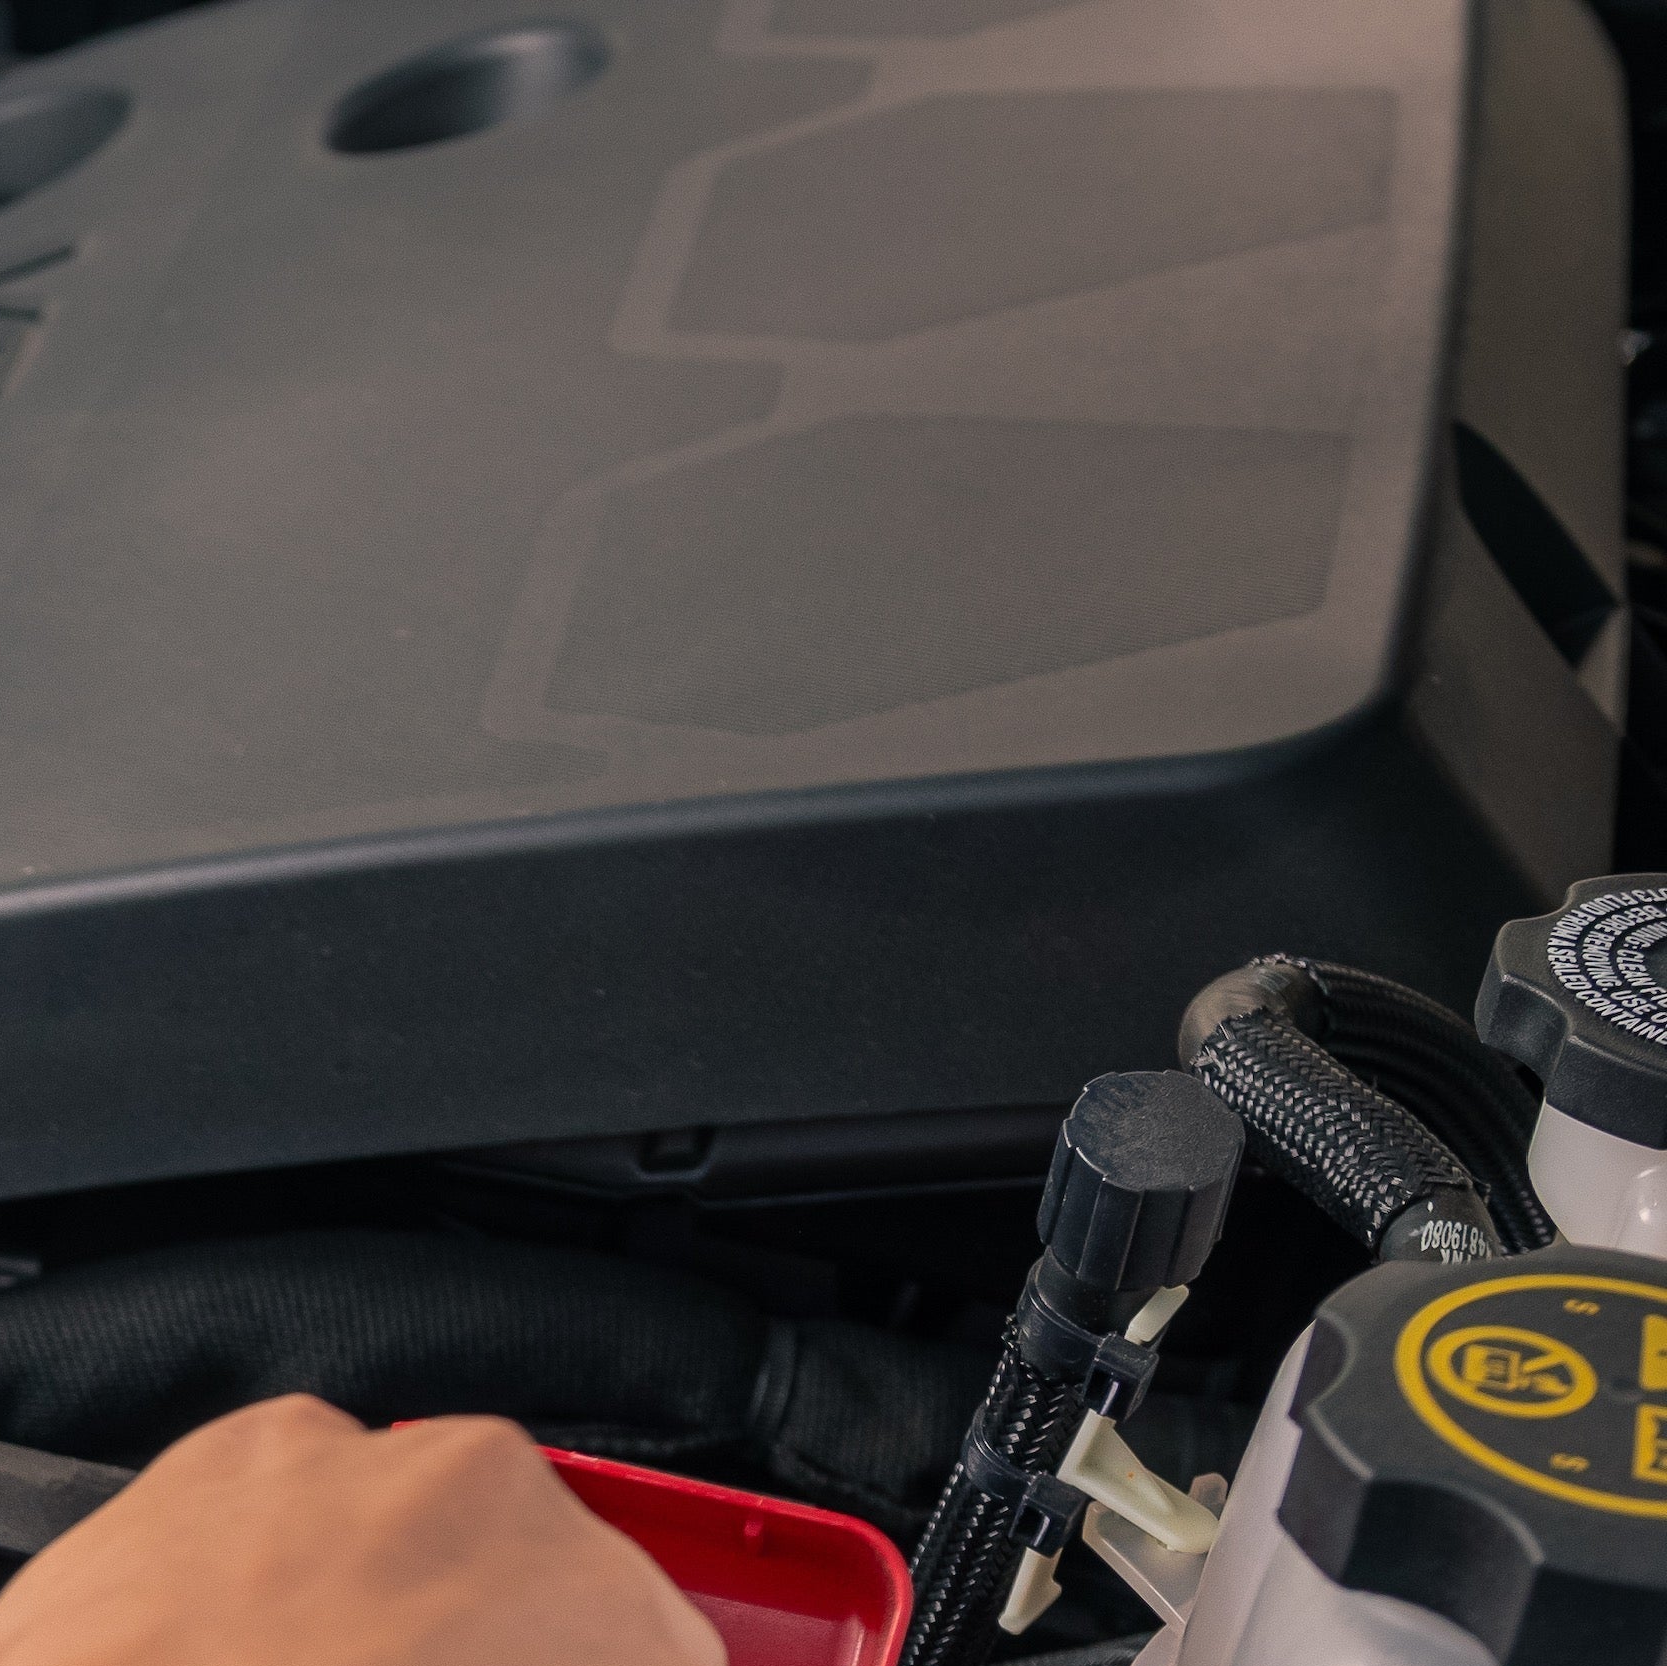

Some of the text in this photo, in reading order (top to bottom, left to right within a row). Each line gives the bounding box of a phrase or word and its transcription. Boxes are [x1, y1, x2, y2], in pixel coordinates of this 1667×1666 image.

[1580, 892, 1639, 916] FLUID
[1594, 904, 1667, 936] BEFORE
[1550, 909, 1597, 941] FROM
[1547, 939, 1576, 948] A
[1547, 948, 1593, 990] SEALED
[1617, 949, 1657, 987] CLEAN
[1575, 989, 1667, 1046] CONTAINE
[1610, 989, 1658, 1016] USE
